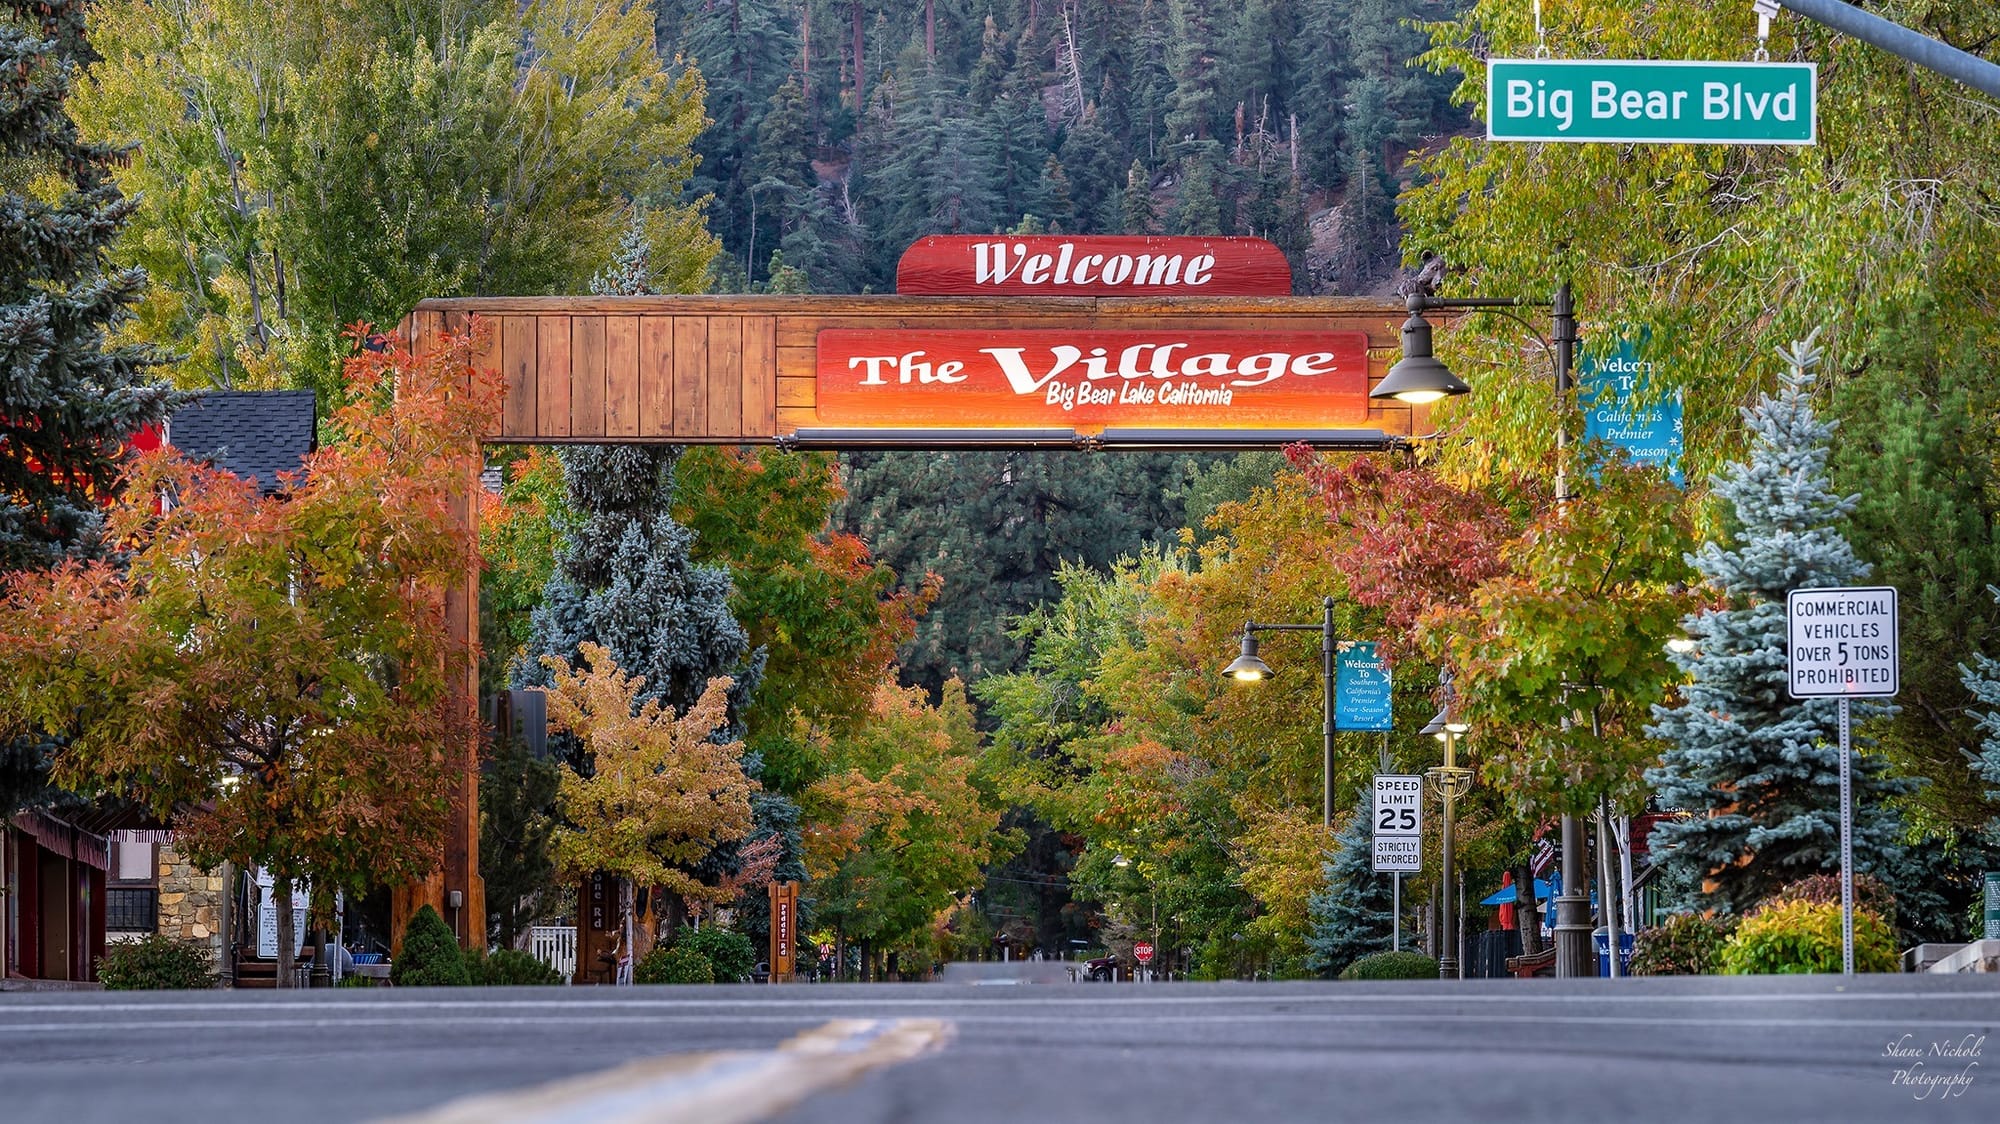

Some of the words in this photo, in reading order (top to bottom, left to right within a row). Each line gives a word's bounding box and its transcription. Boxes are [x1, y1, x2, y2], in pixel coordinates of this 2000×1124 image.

[1507, 79, 1574, 132] Big
[1591, 80, 1688, 120] Bear
[1703, 81, 1797, 121] Blvd
[971, 242, 1216, 286] Welcome
[848, 350, 969, 385] The
[978, 343, 1338, 394] Village
[1046, 380, 1075, 411] Big
[1077, 380, 1116, 405] Bear
[1119, 380, 1155, 405] Lake
[1158, 380, 1233, 406] California
[1606, 428, 1654, 440] Premier
[1796, 600, 1888, 617] COMMERCIAL
[1803, 622, 1880, 639] VEHICLES
[1796, 646, 1831, 662] OVER
[1838, 642, 1848, 666] 5
[1853, 645, 1889, 660] TONS
[1358, 669, 1370, 678] To
[1797, 668, 1890, 684] PROHIBITED
[1349, 678, 1378, 686] Southern
[1345, 687, 1382, 697] California's
[1351, 696, 1376, 704] Premier
[1352, 714, 1374, 722] Resort
[1377, 781, 1419, 791] SPEED
[1381, 795, 1415, 804] LIMIT
[1379, 808, 1416, 830] 25
[1377, 842, 1417, 852] STRICTLY
[1376, 854, 1419, 864] ENFORCED
[593, 907, 603, 928] Rd
[780, 943, 786, 955] Rd
[1136, 946, 1153, 955] STOP
